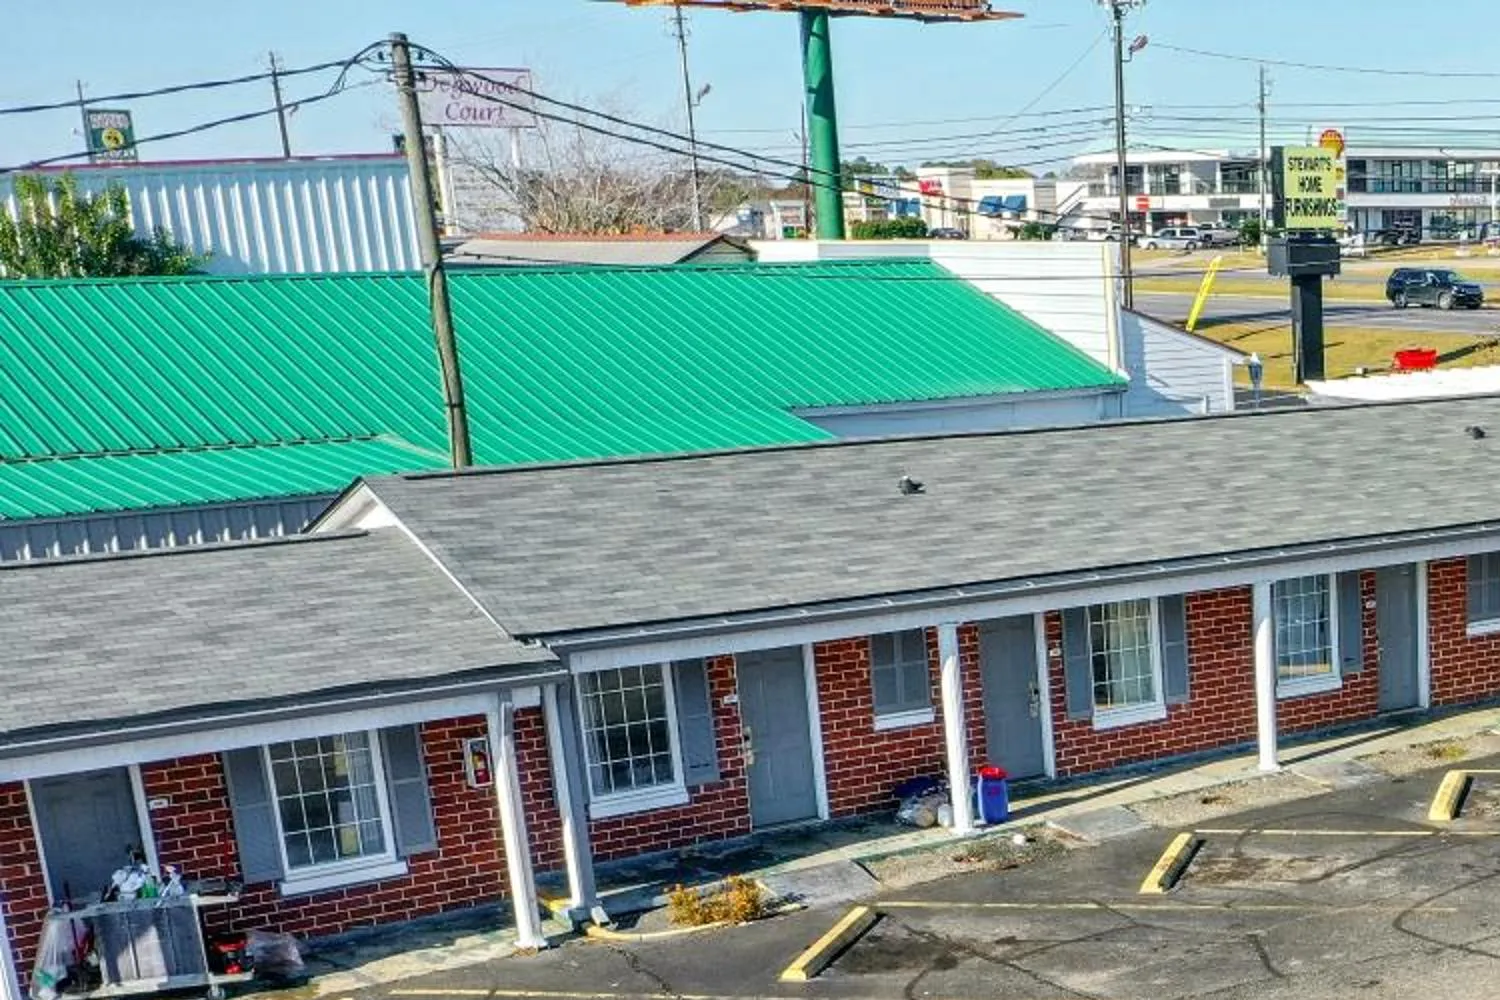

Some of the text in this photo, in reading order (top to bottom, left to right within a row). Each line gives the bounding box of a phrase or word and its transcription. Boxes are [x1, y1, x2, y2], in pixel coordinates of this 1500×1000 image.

[445, 102, 503, 121] Court
[1299, 175, 1322, 192] HOME
[1286, 197, 1336, 216] FURNISHINGS
